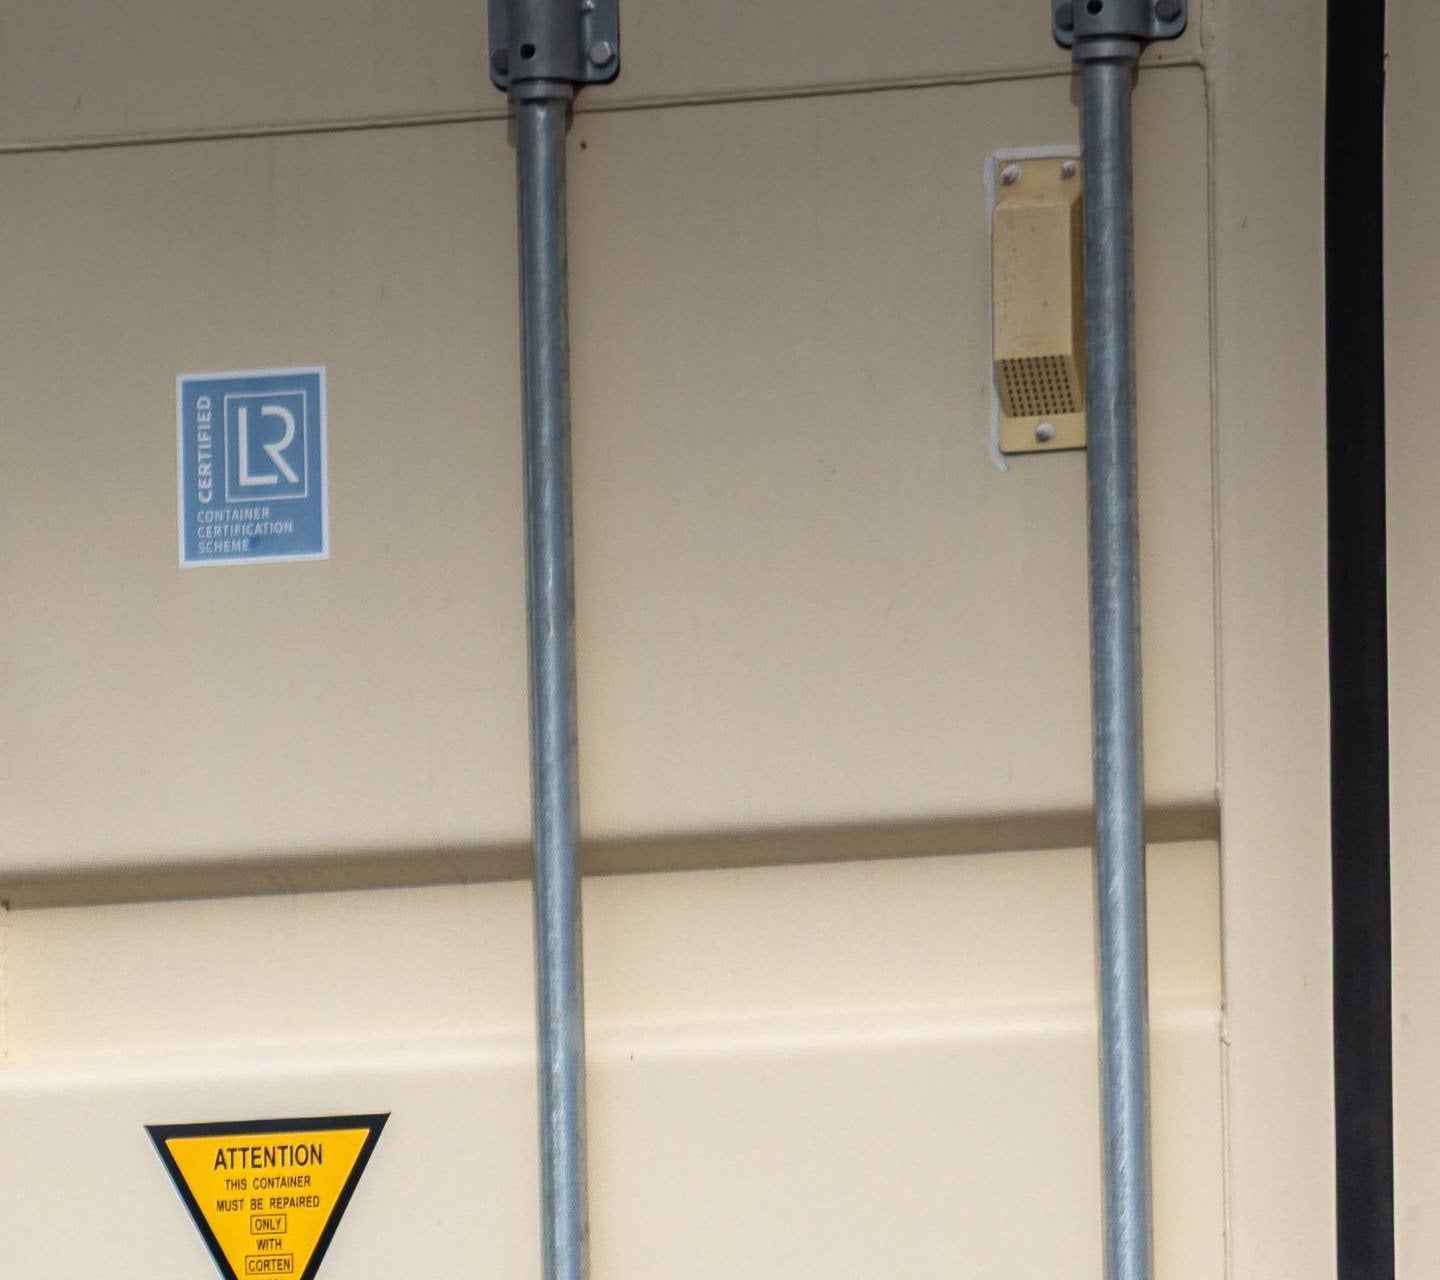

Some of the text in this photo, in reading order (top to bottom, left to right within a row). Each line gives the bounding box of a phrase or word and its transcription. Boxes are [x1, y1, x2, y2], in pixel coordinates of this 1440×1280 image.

[196, 396, 213, 504] CERTIFIED
[237, 405, 300, 487] LR
[196, 507, 270, 524] CONTAINER
[196, 521, 293, 539] CERTIFICATION
[197, 538, 251, 554] SCHEME
[214, 1144, 323, 1171] ATTENTION
[225, 1175, 311, 1191] THIS CONTAINER
[216, 1195, 321, 1212] MUST BE REPAIRED
[254, 1218, 282, 1232] ONLY
[256, 1239, 283, 1251] WITH
[248, 1258, 291, 1272] CORTEN
